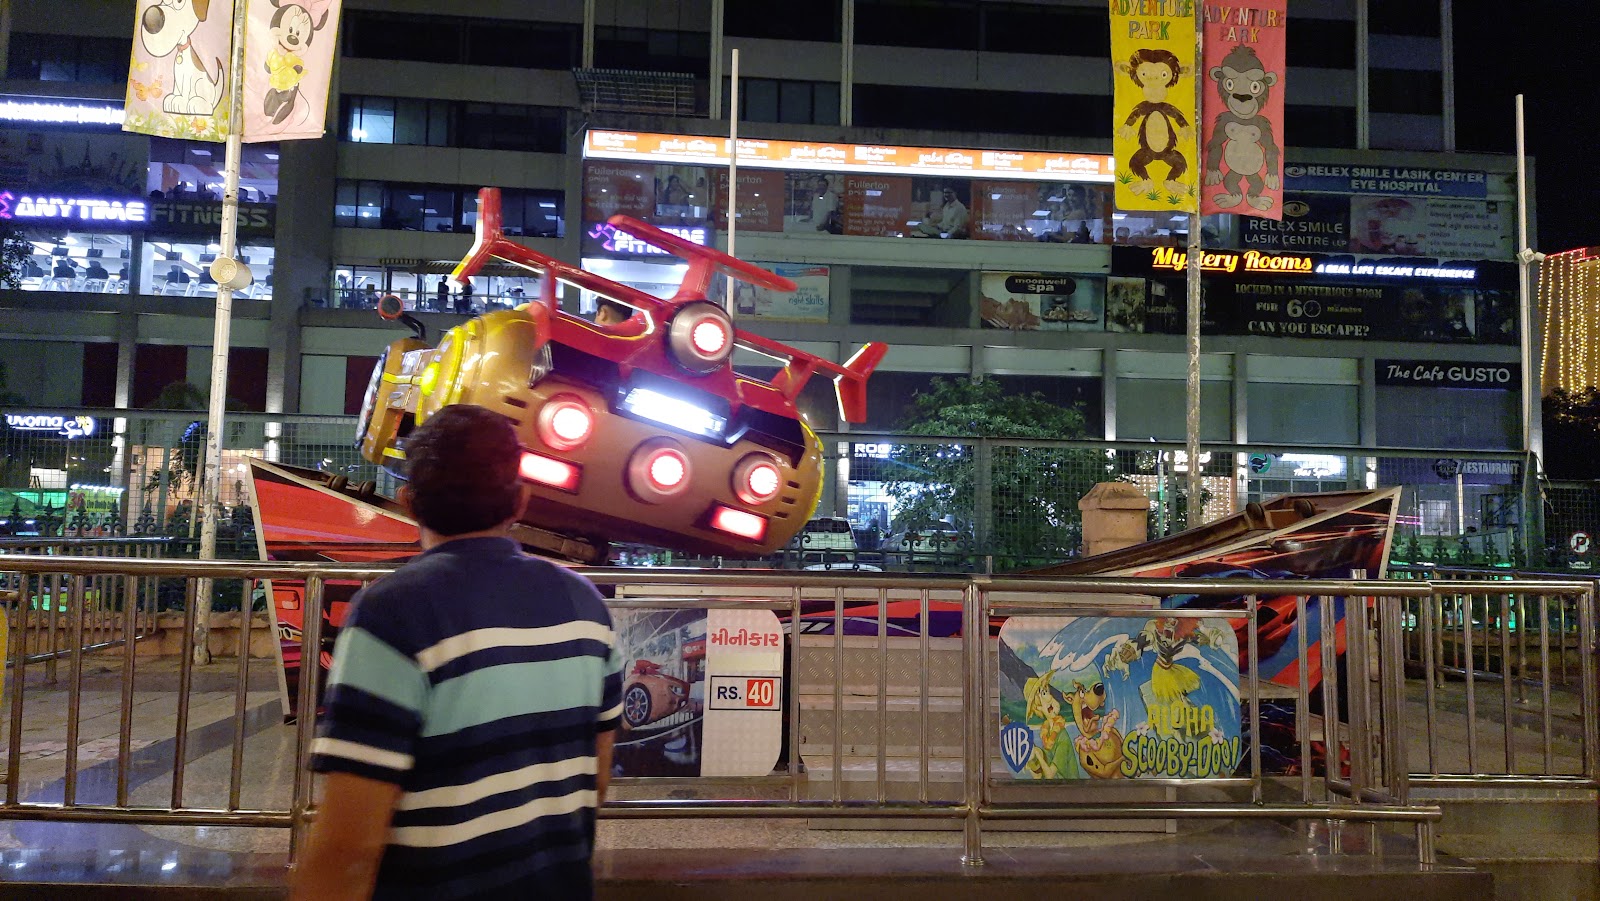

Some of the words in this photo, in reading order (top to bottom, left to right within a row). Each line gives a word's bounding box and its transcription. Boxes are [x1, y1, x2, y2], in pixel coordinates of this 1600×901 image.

[1111, 0, 1193, 17] ADVENTURE
[1204, 5, 1284, 28] ADVENTURE
[1128, 20, 1170, 40] PARK
[1220, 26, 1260, 43] PARK
[720, 174, 762, 184] Fuerton
[1307, 166, 1349, 177] RELEX
[1351, 169, 1390, 179] SMILE
[1393, 170, 1431, 180] LASIK
[1434, 171, 1485, 184] CENTER
[848, 180, 890, 190] Fullerton
[1351, 179, 1376, 190] EYE
[1379, 181, 1441, 192] HOSPITAL
[14, 197, 146, 221] ANYTIME
[1249, 219, 1295, 232] RELEX
[1299, 221, 1343, 234] SMILE
[1244, 233, 1278, 244] LASIK
[1282, 235, 1329, 246] CENTRE
[1152, 246, 1238, 272] Mytery
[1243, 249, 1313, 271] Rooms
[1315, 264, 1325, 274] A
[1325, 264, 1350, 274] REAL
[1352, 266, 1374, 275] LIFE
[1375, 266, 1413, 277] ESCAPE
[1414, 268, 1475, 279] EXPERIENCE
[1015, 278, 1067, 286] moonwell
[1027, 284, 1055, 293] spa
[1235, 283, 1272, 294] LOCKED
[1274, 285, 1284, 295] IN
[788, 295, 804, 306] right
[805, 295, 824, 306] skills
[1255, 301, 1278, 312] FOR
[1247, 320, 1275, 332] CAN
[1279, 322, 1306, 334] YOU
[1310, 323, 1370, 336] ESCAPE?
[1386, 365, 1410, 379] The
[1413, 365, 1445, 381] Cafe
[1448, 367, 1510, 383] GUSTO
[710, 628, 779, 647] મીનીકાર
[717, 687, 742, 700] RS.
[748, 681, 773, 704] 40
[1149, 704, 1214, 737] ALOHA
[1004, 729, 1029, 763] WB
